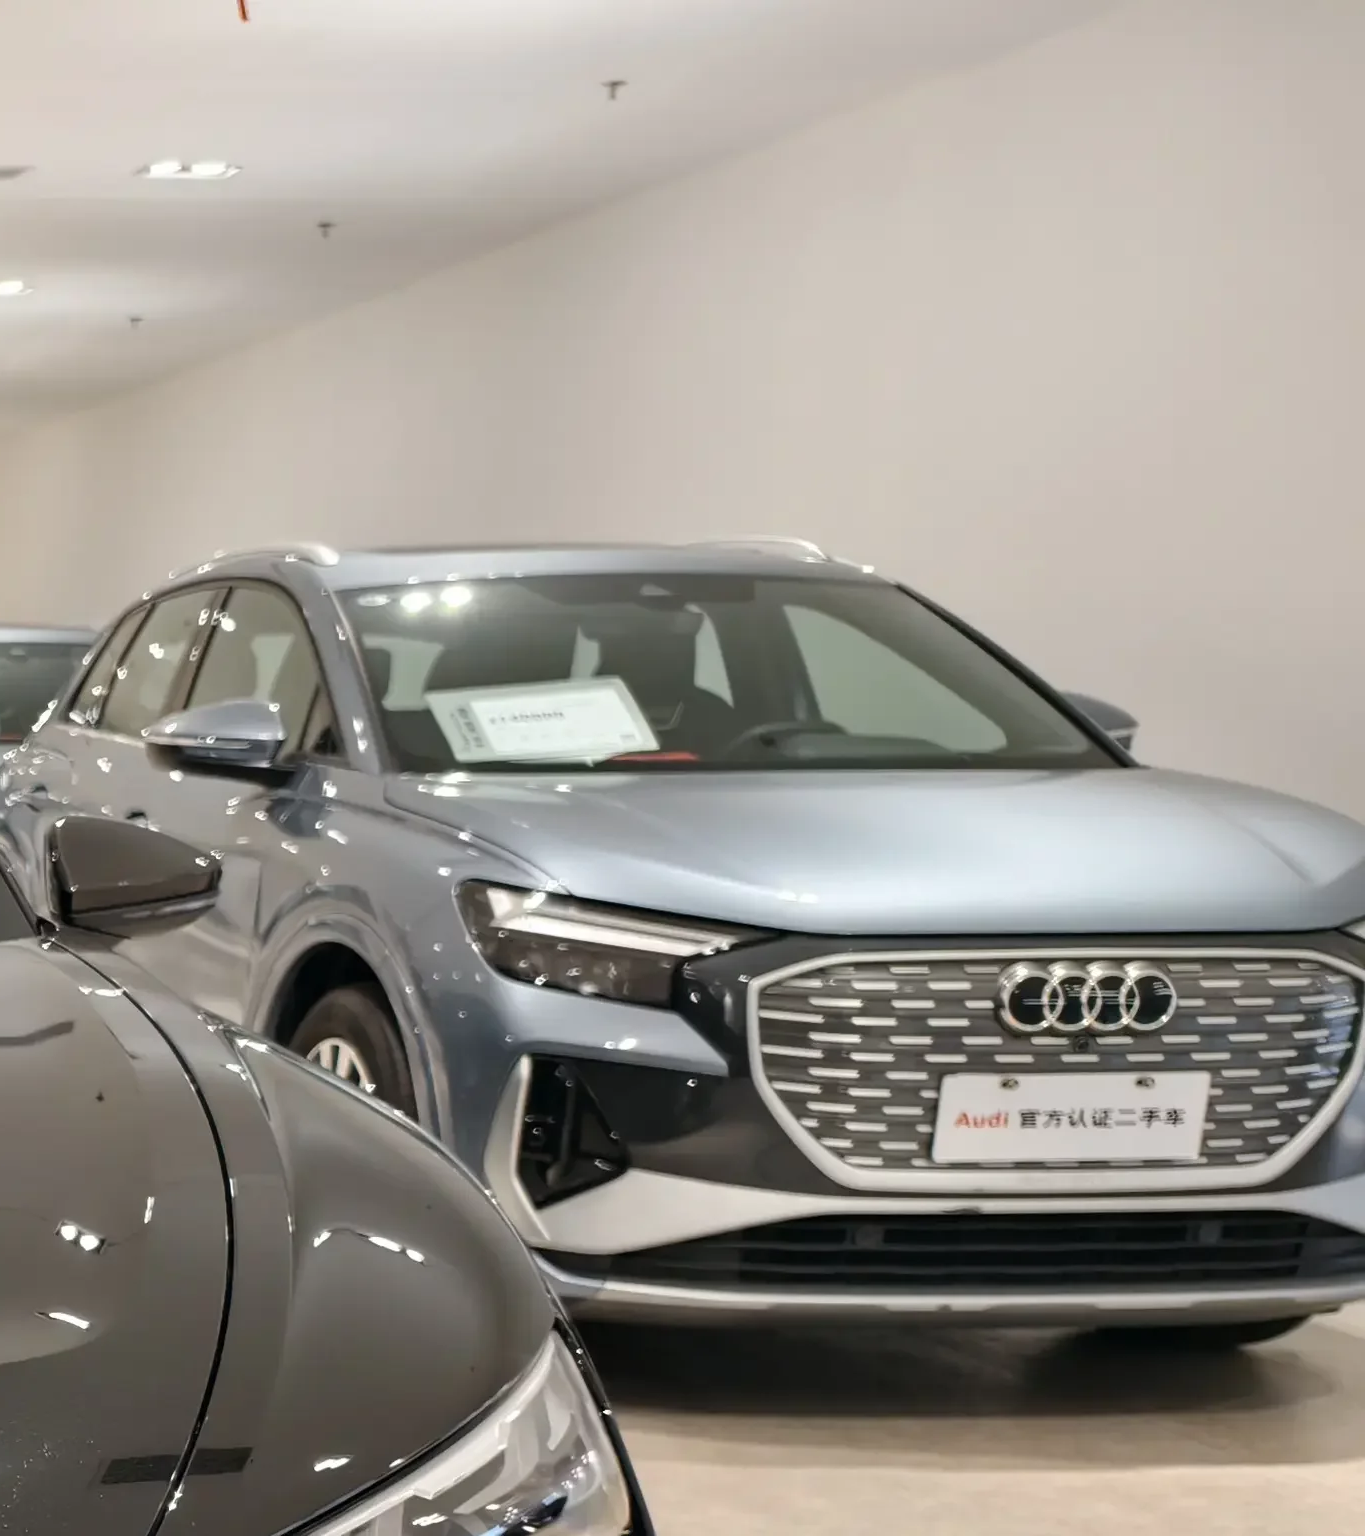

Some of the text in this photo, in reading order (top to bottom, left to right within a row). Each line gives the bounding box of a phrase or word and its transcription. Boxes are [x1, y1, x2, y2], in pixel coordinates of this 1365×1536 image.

[954, 1108, 1187, 1130] Audi 官方认证二手车
